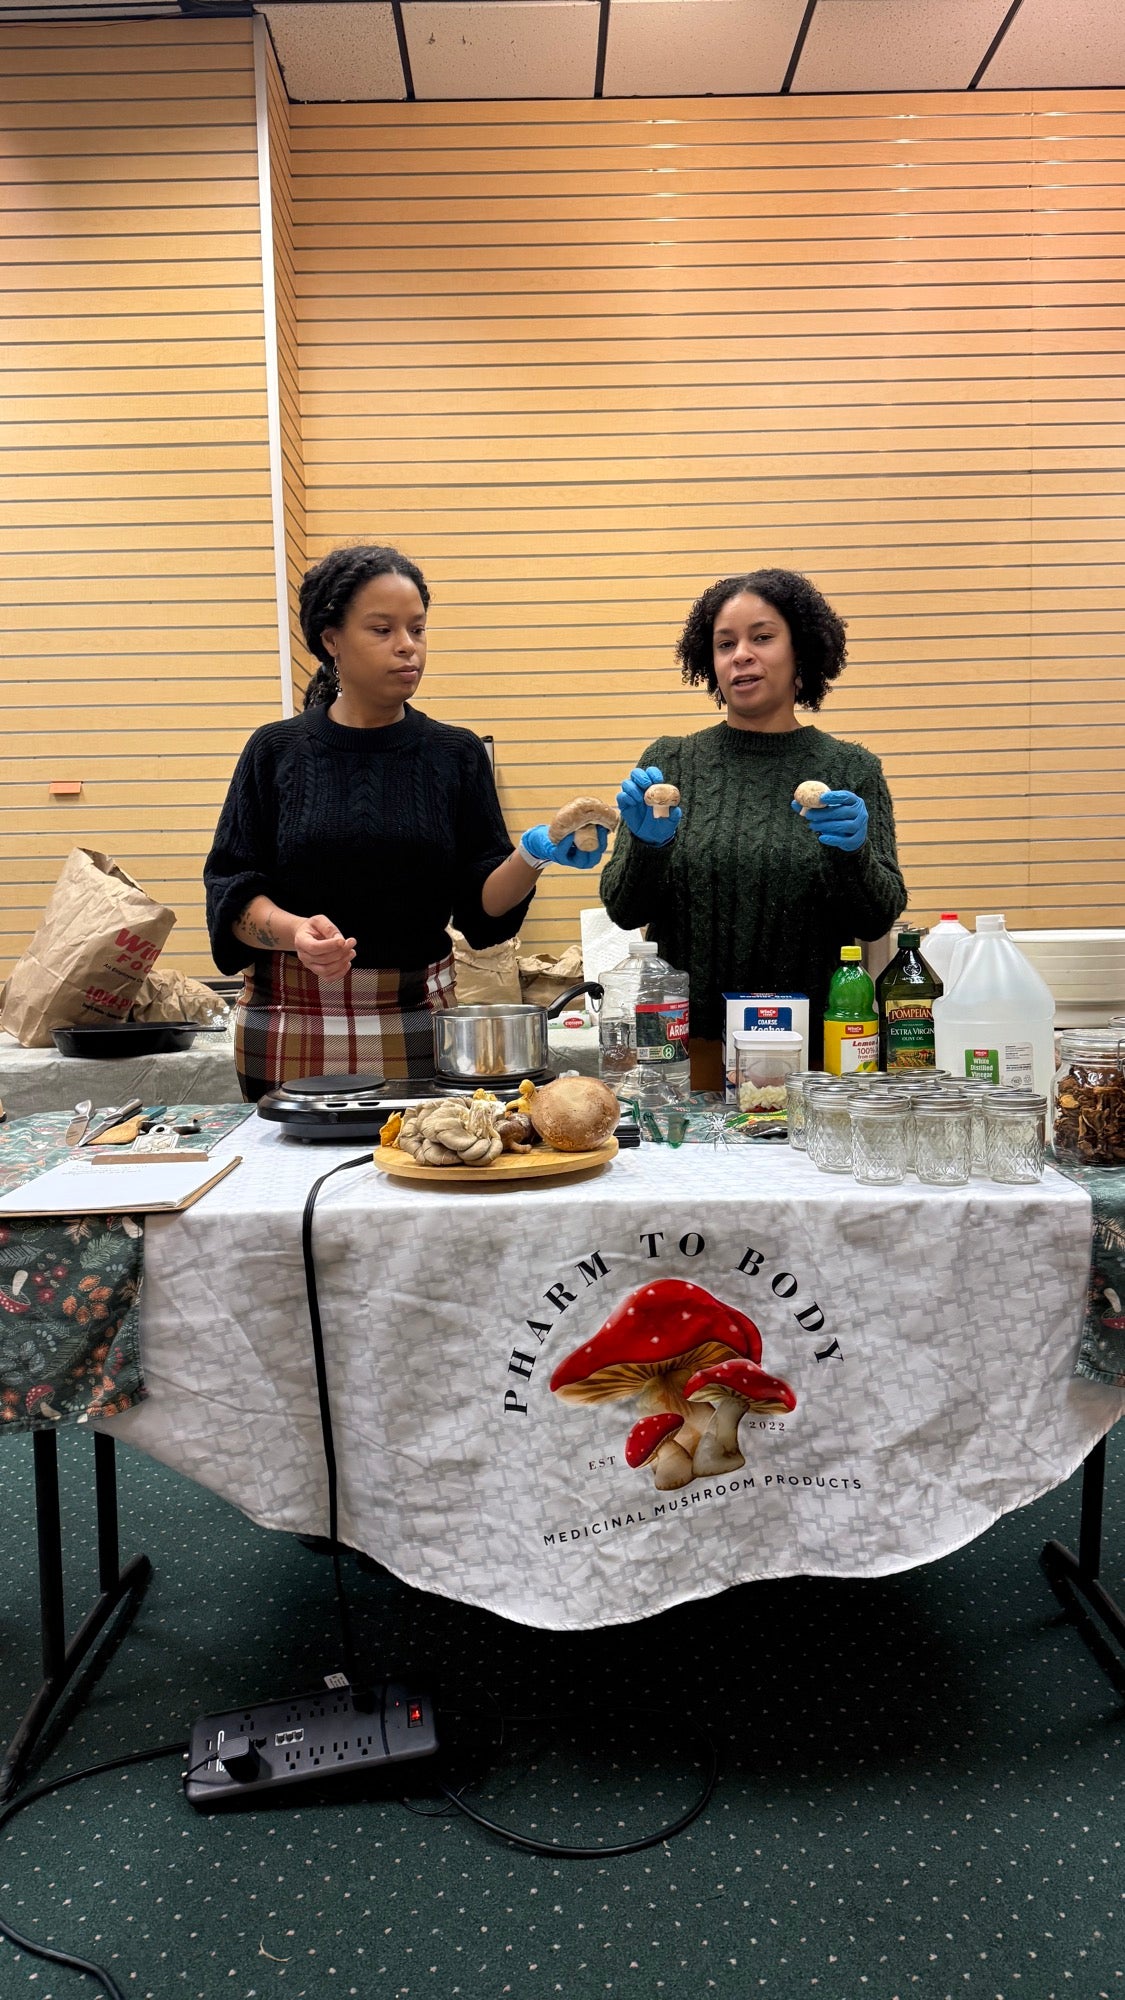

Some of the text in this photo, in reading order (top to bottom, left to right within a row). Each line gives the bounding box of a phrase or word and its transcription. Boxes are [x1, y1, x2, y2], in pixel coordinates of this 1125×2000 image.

[891, 1008, 934, 1020] POMPEIAN
[890, 1028, 912, 1036] EXTRA
[504, 1231, 844, 1416] PHARM TO BODY
[749, 1419, 786, 1432] 2022
[588, 1455, 617, 1471] EST
[543, 1475, 863, 1546] MEDICINAL MUSHROOM PRODUCTS
